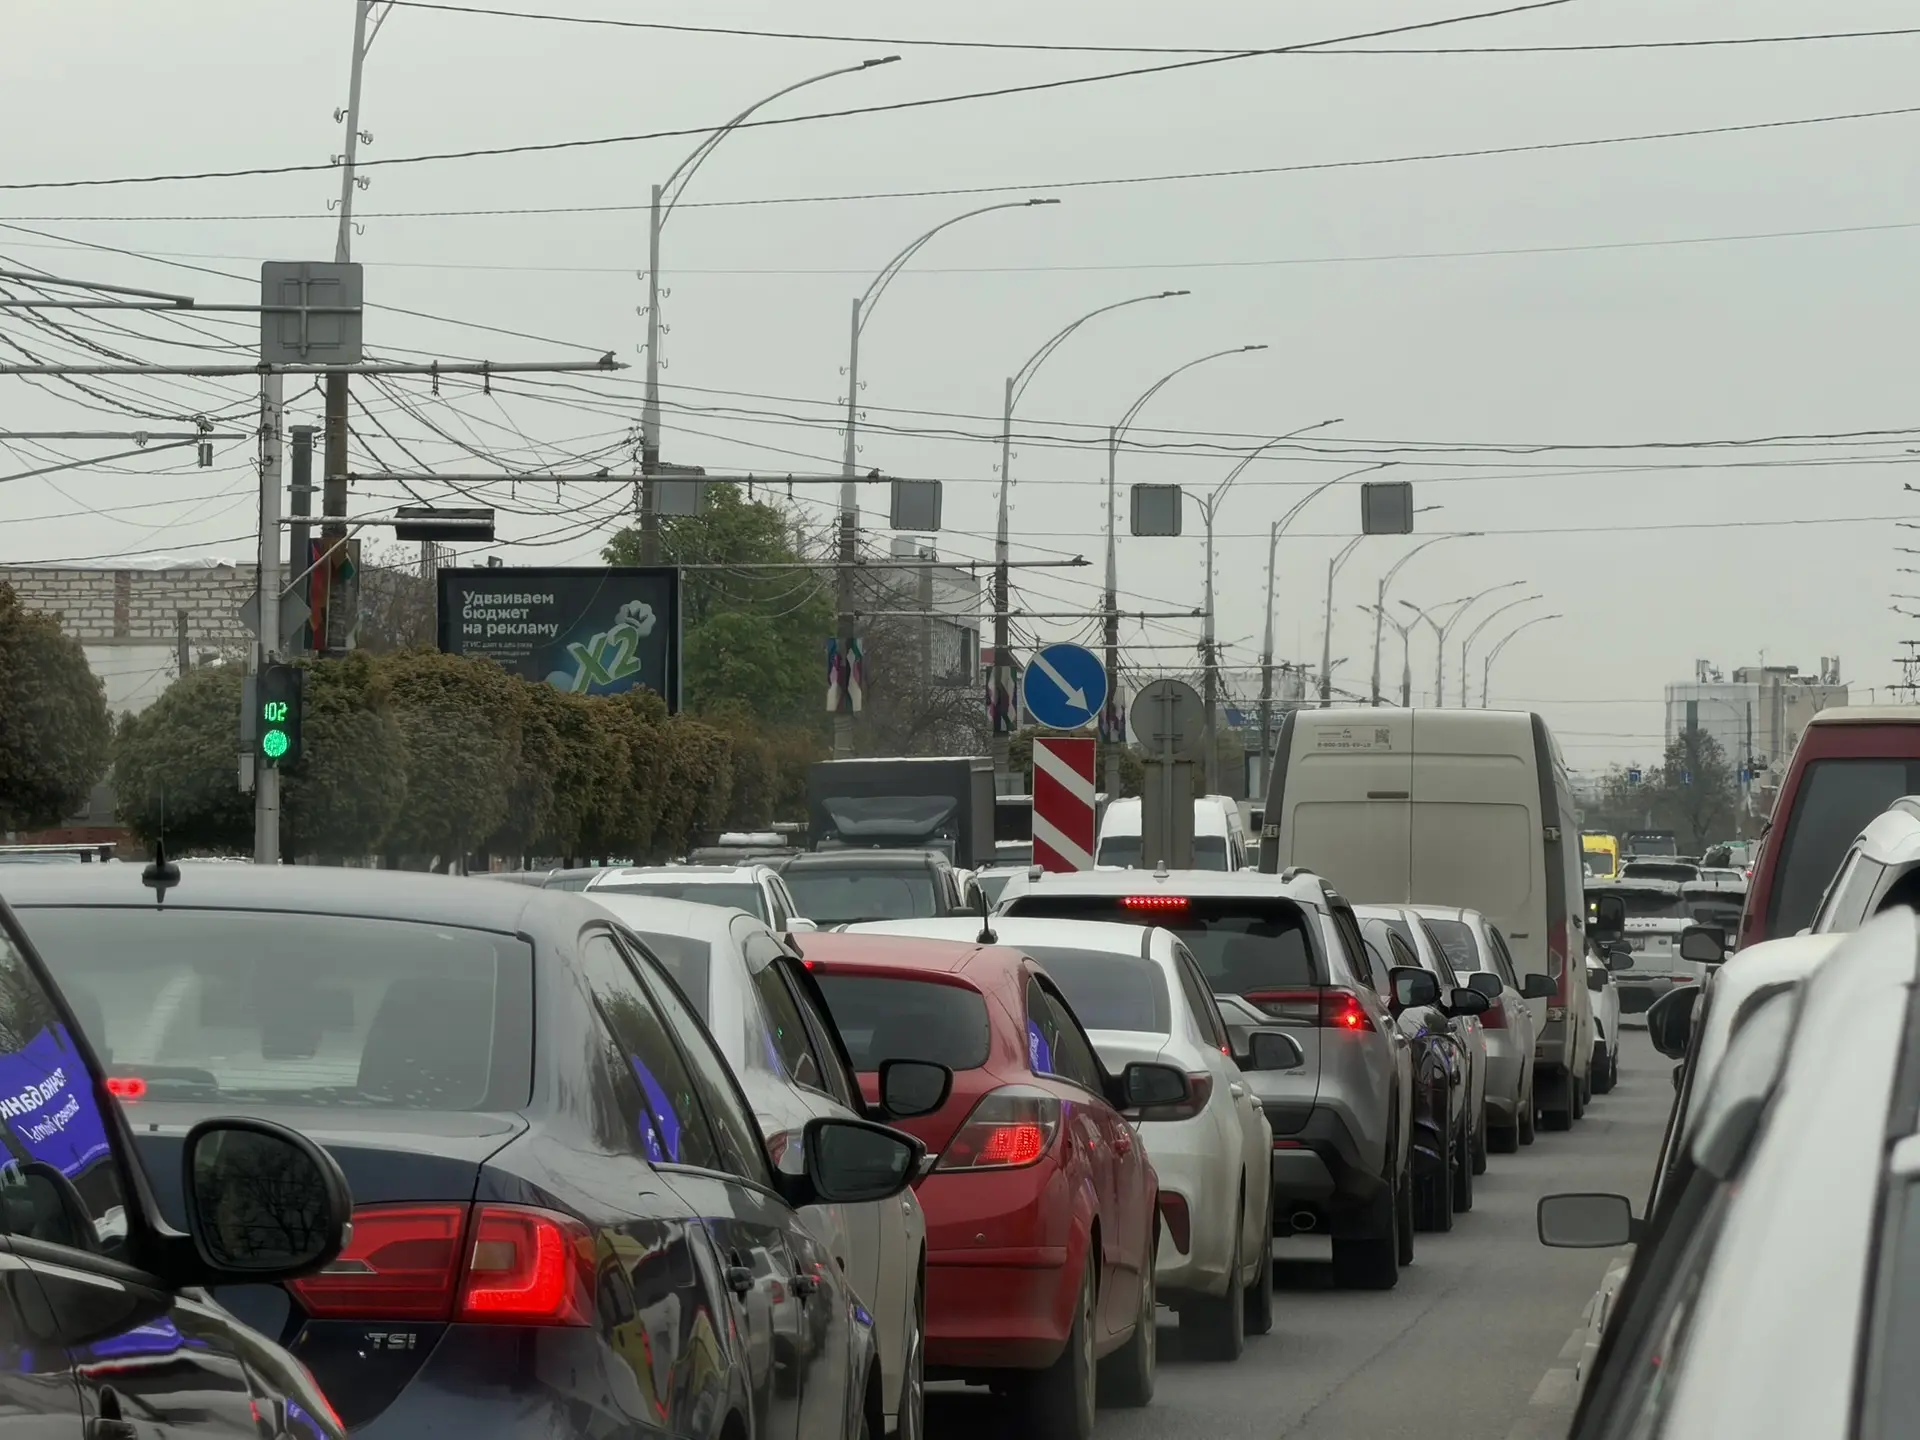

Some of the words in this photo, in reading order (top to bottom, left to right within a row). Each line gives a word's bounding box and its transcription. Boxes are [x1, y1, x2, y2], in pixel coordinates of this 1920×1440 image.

[462, 590, 554, 606] Удваиваем
[462, 605, 529, 621] бюджет
[462, 623, 482, 634] на
[487, 623, 559, 637] рекламу
[264, 702, 288, 721] 102
[367, 1332, 417, 1349] TSI
